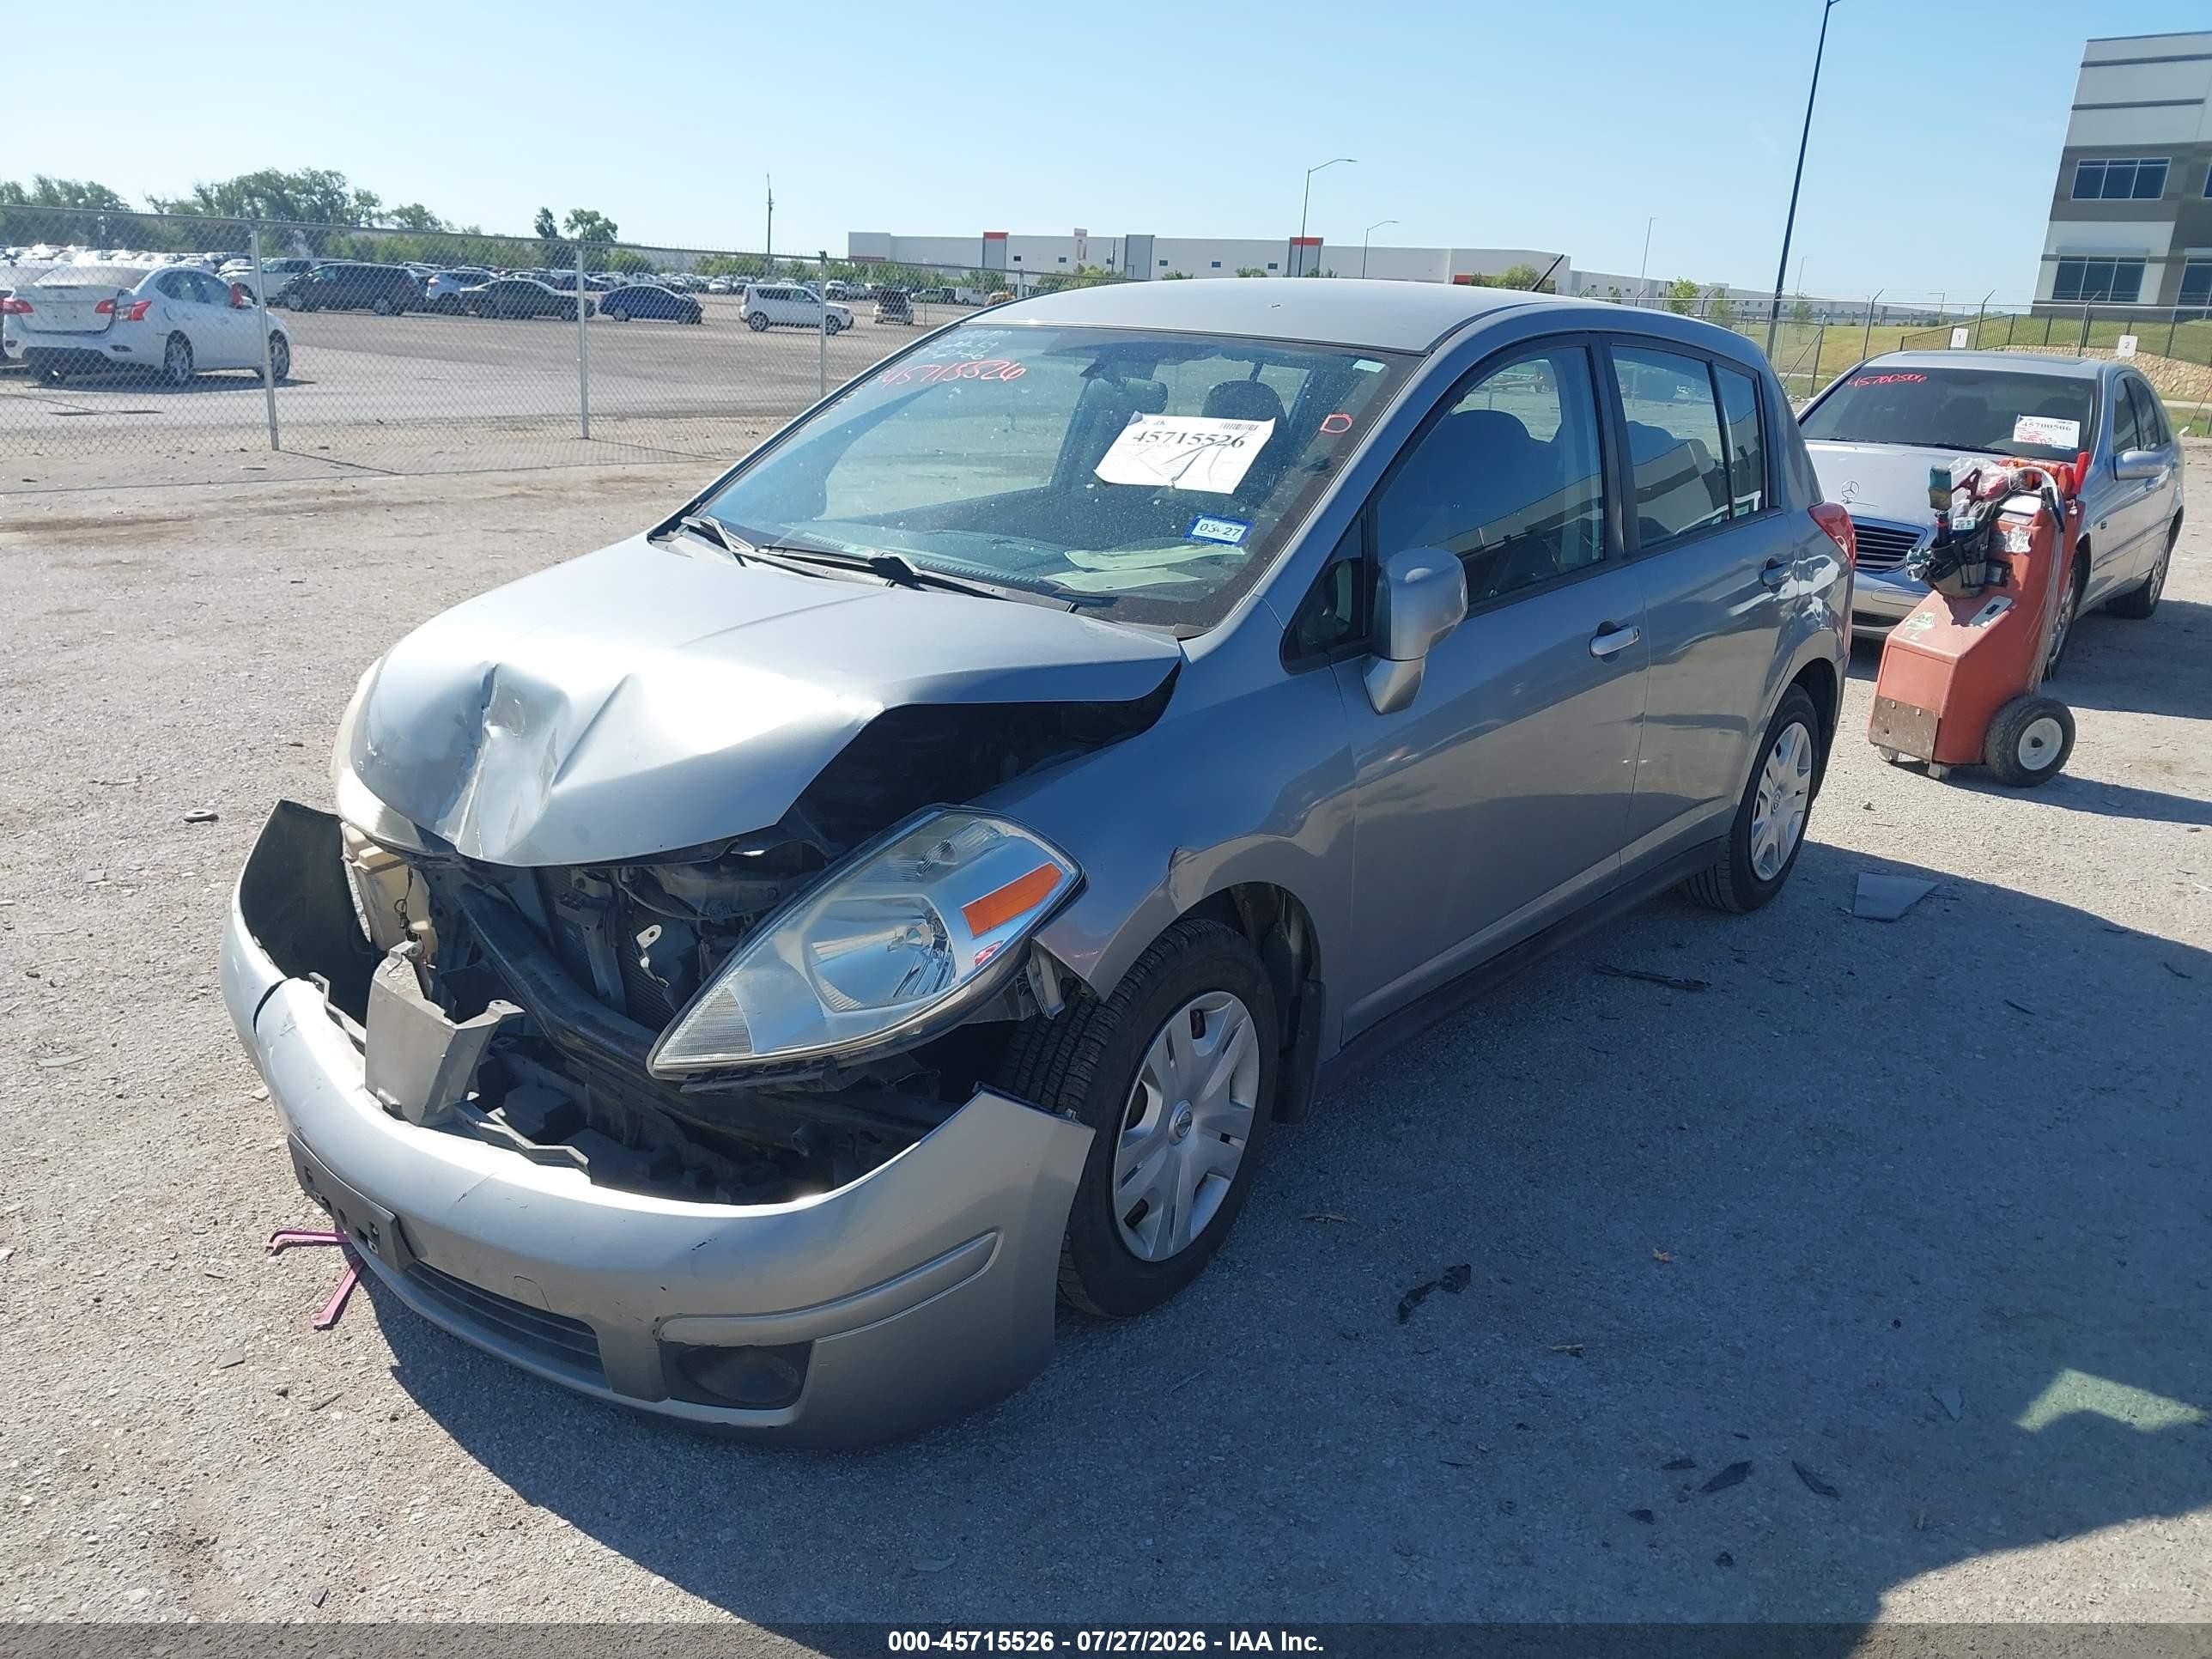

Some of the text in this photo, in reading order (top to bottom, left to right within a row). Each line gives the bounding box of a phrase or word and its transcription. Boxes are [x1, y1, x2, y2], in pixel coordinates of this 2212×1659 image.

[881, 360, 1027, 389] 45715526
[1319, 412, 1354, 434] D
[1133, 429, 1246, 449] 45715526
[1221, 526, 1243, 537] 27
